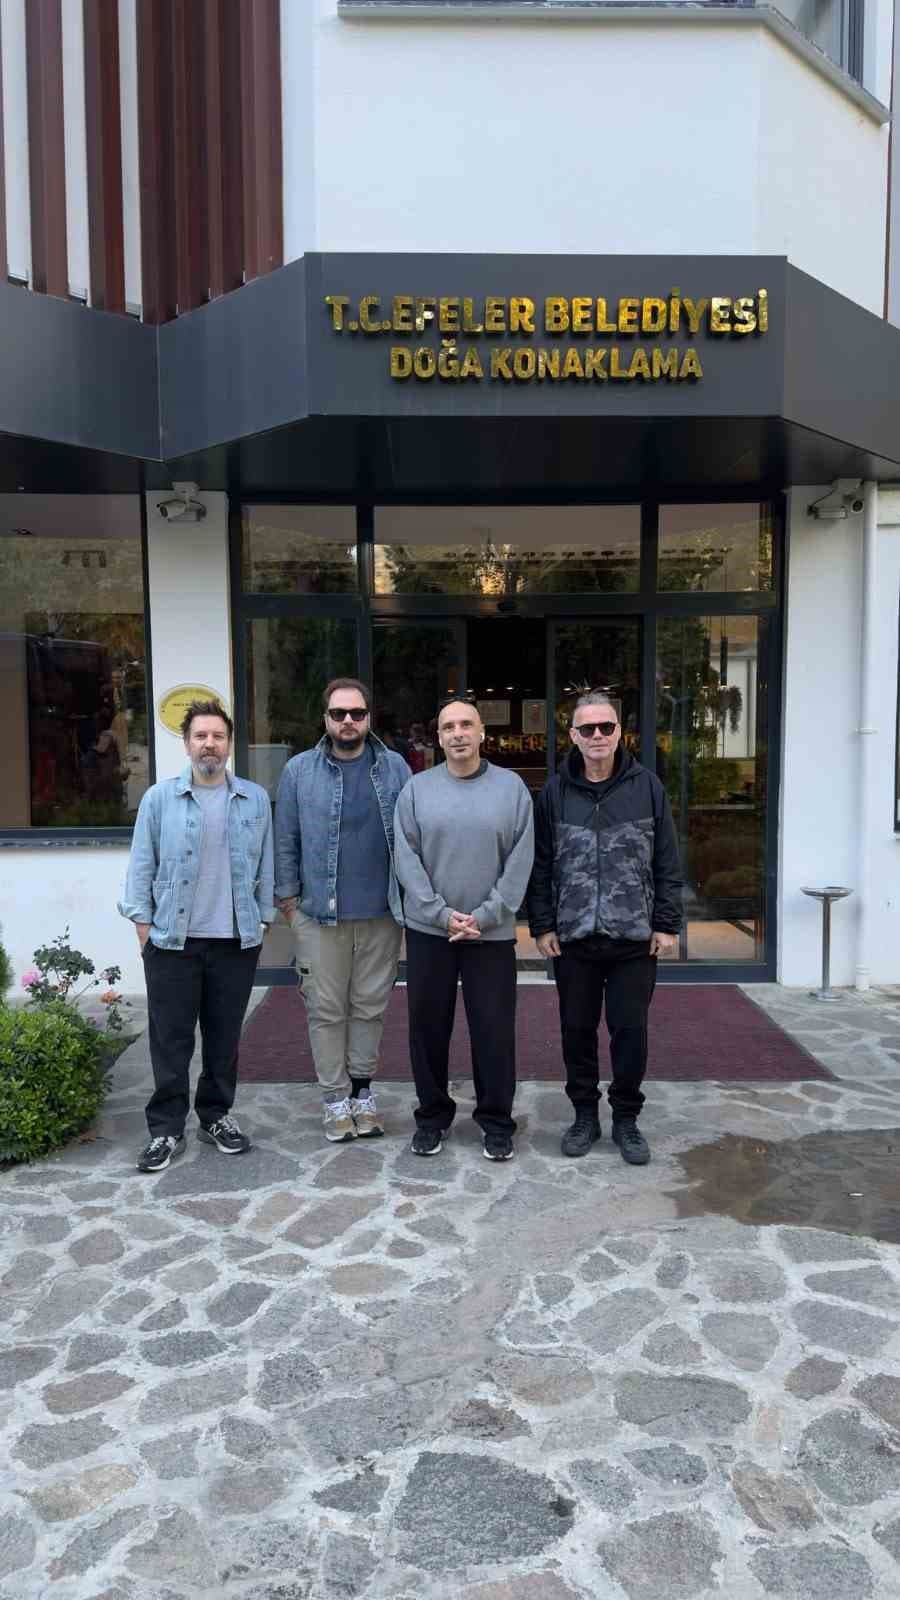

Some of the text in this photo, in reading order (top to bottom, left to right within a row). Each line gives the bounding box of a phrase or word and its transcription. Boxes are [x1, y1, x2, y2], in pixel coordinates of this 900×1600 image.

[545, 287, 768, 333] BELEDİYESİ
[390, 338, 703, 378] DOĞA KONAKLAMA
